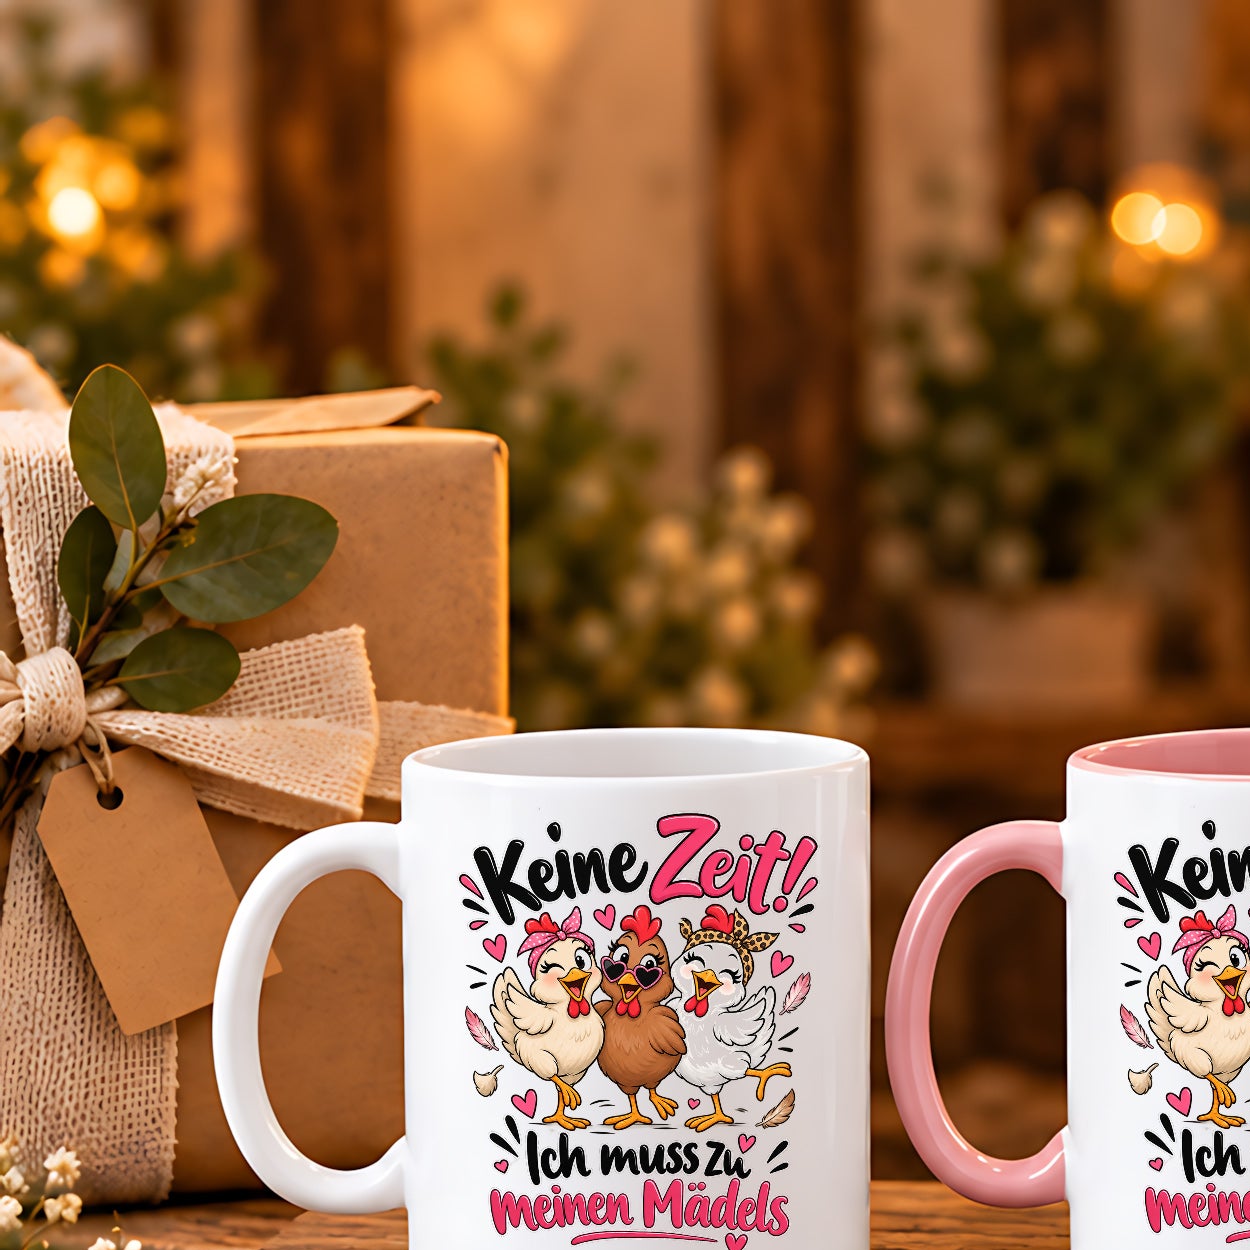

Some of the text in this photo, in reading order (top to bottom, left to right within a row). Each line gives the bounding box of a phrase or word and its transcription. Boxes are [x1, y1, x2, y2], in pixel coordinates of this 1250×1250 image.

[473, 813, 817, 925] Keine Zeit!
[525, 1131, 590, 1185] Ich
[601, 1142, 700, 1177] muss
[1180, 1129, 1245, 1183] Ich
[490, 1179, 789, 1236] meinen Mädels
